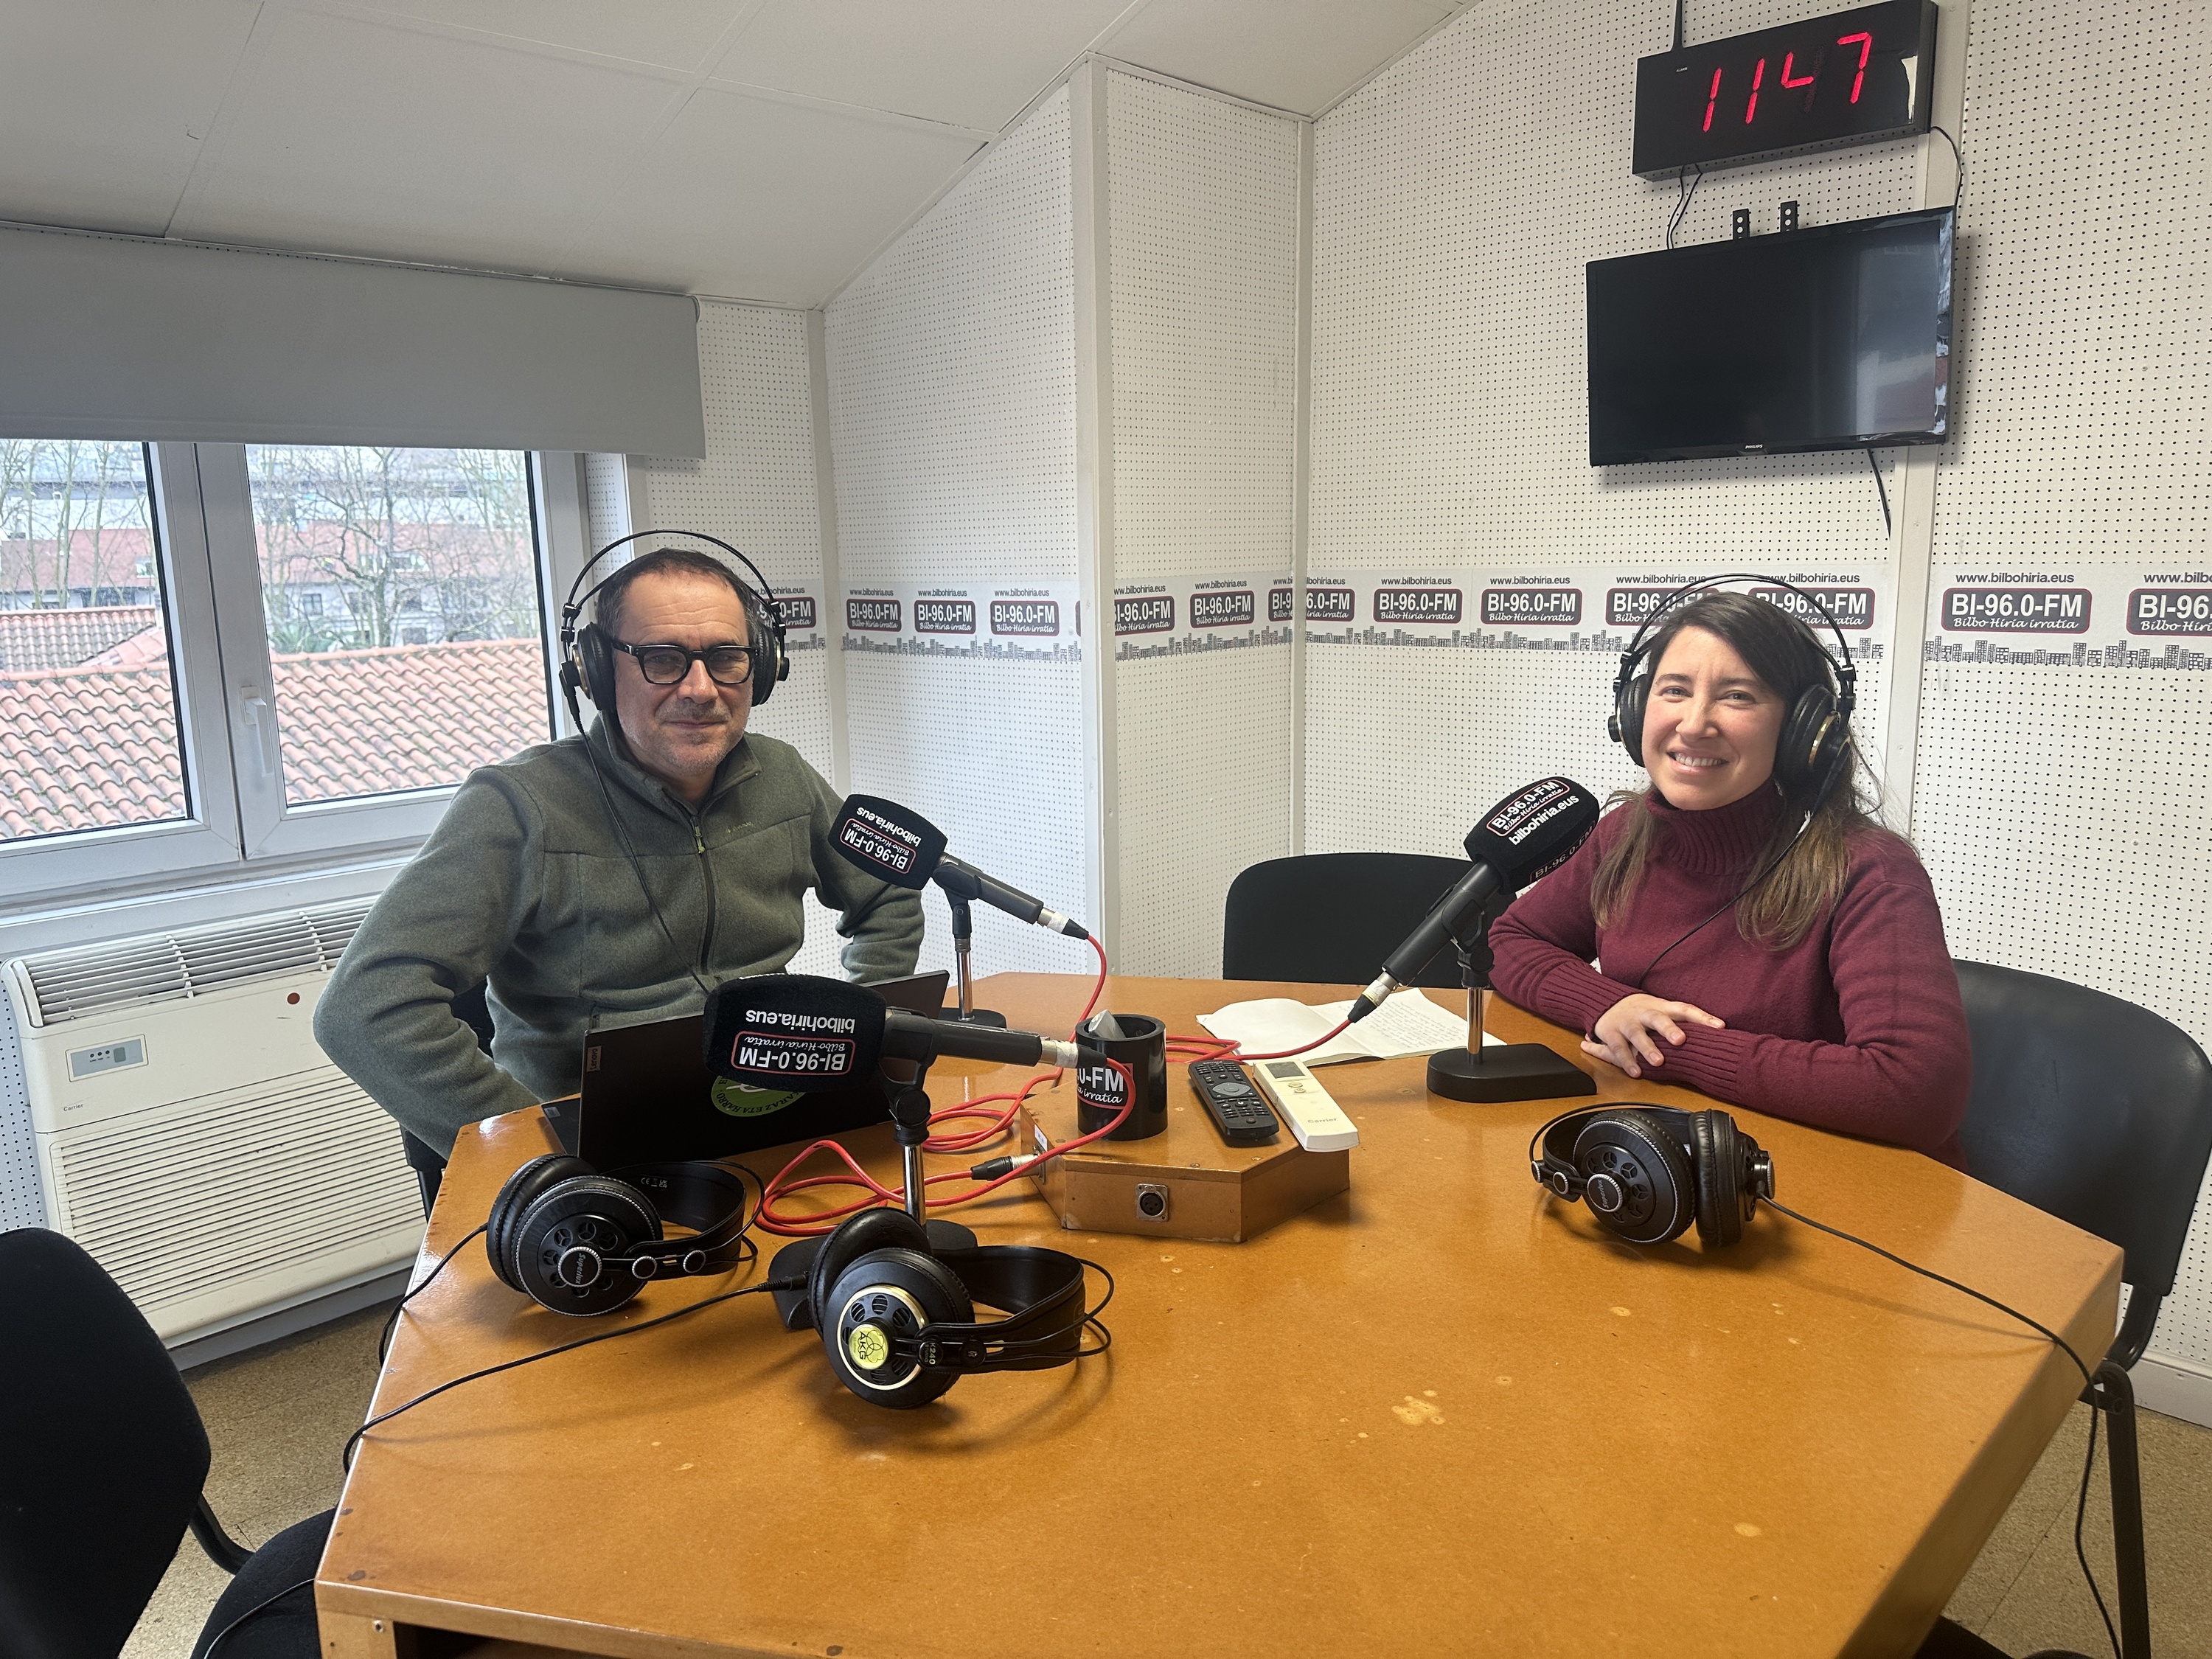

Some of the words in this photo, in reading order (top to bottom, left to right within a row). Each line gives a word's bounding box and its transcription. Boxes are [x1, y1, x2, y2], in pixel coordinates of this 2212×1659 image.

[1194, 580, 1247, 590] www.bilbohiria.eus
[1381, 577, 1452, 585] www.bilbohiria.eus
[1489, 576, 1571, 585] www.bilbohiria.eus
[1955, 573, 2075, 584] www.bilbohiria.eus
[849, 588, 894, 597] www.bilbohiria.eus
[917, 588, 967, 597] www.bilbohiria.eus
[994, 588, 1049, 597] www.bilbohiria.eus
[1194, 594, 1251, 616] BI-96.0-FM
[1379, 593, 1457, 611] BI-96.0-FM
[1487, 593, 1576, 612] BI-96.0-FM
[1952, 593, 2082, 617] BI-96.0-FM
[850, 602, 899, 621] BI-96.0-FM
[917, 604, 972, 622] BI-96.0-FM
[995, 605, 1055, 624] BI-96.0-FM
[1380, 611, 1401, 619] Bilbo
[1425, 611, 1455, 620] irratia
[1489, 613, 1512, 622] Bilbo
[1512, 613, 1540, 622] Hiria
[1540, 613, 1574, 622] irratia
[1615, 613, 1642, 622] Bilbo
[1953, 617, 1989, 627] Bilbo
[1989, 617, 2028, 627] Hiria
[2029, 619, 2079, 629] irratia
[2140, 619, 2181, 630] Bilbo
[1491, 781, 1560, 829] BI-96.0-FM
[856, 807, 922, 847] bilbohiria.eus
[1508, 795, 1579, 846] bilbohiria.eus
[844, 828, 908, 869] BI-96.0-FM
[745, 1009, 855, 1034] bilbohiria.eus
[744, 1036, 785, 1048] irratia
[817, 1043, 846, 1052] Bilbo
[739, 1046, 846, 1071] BI-96.0-FM
[1083, 1088, 1123, 1103] irratia
[575, 1253, 586, 1284] Superlux
